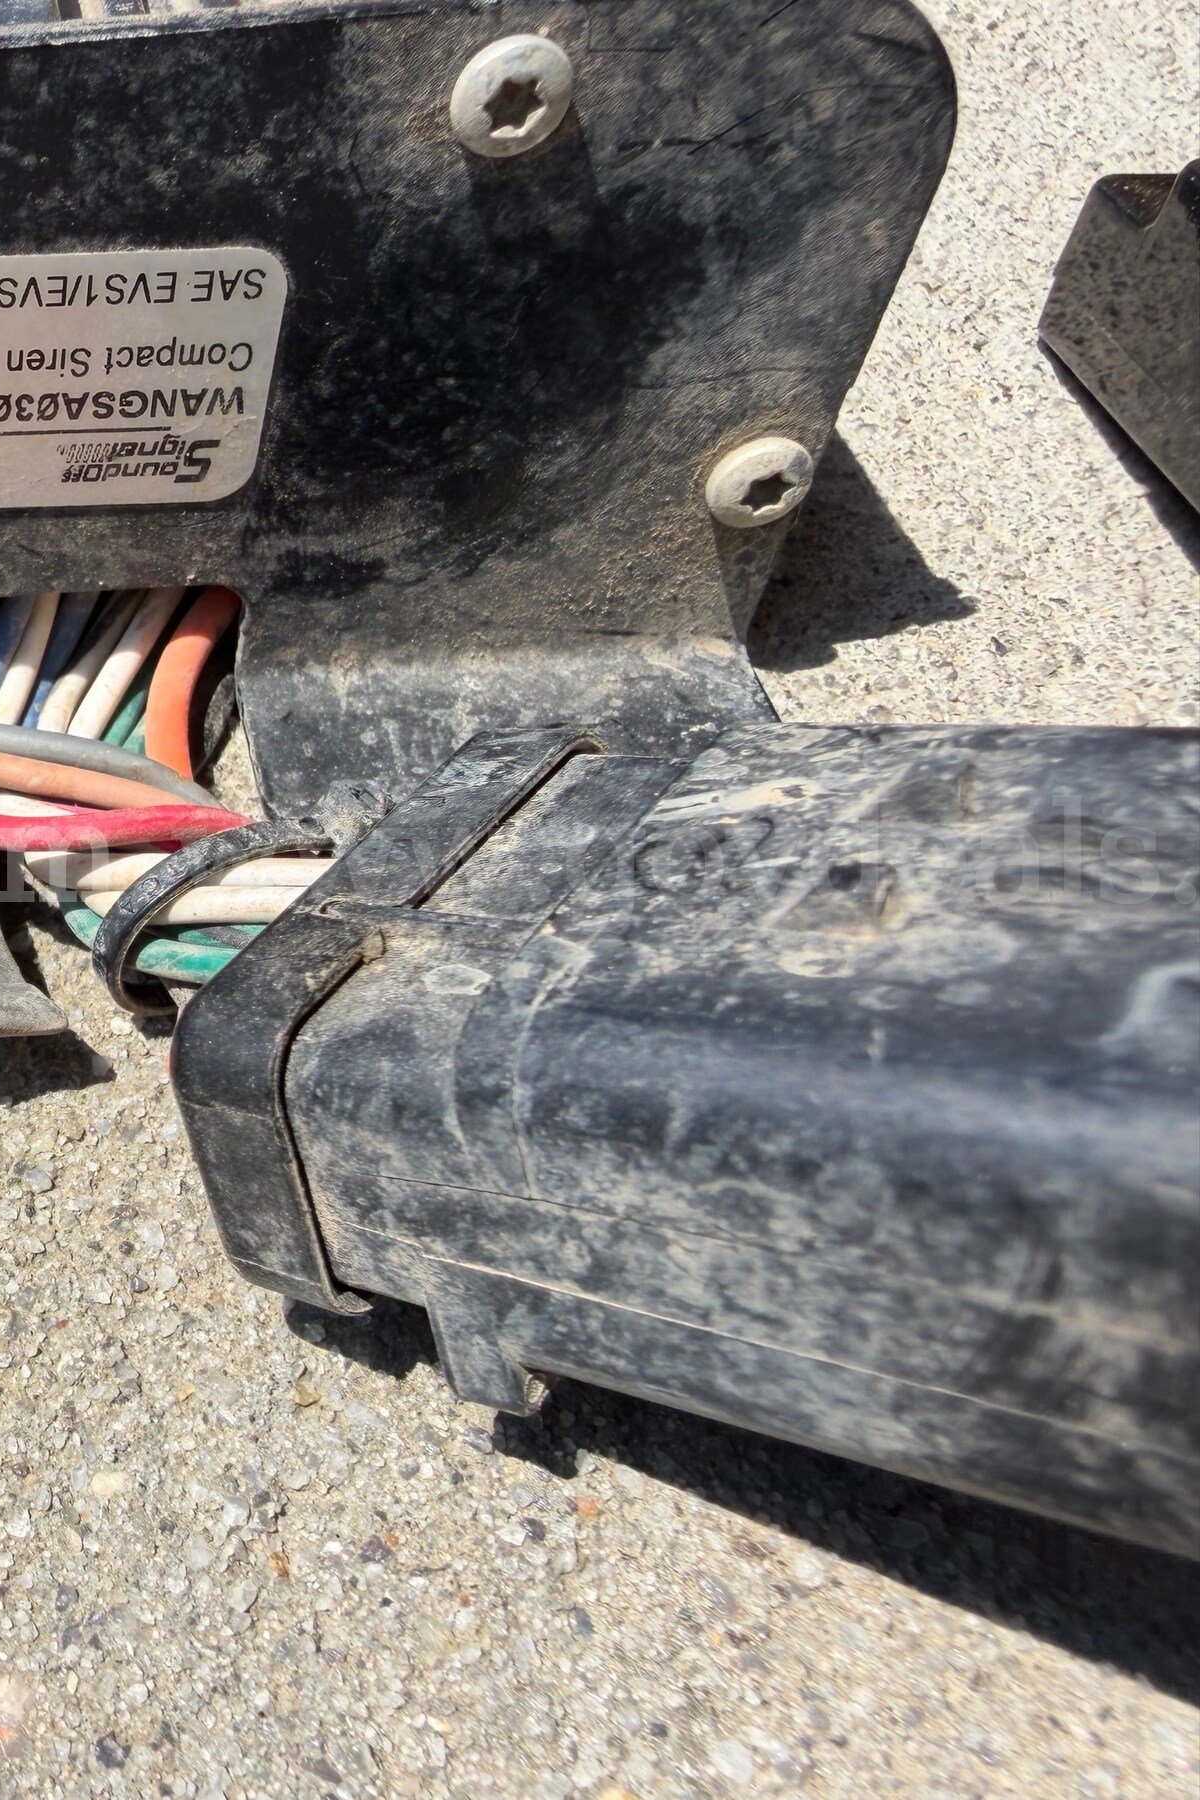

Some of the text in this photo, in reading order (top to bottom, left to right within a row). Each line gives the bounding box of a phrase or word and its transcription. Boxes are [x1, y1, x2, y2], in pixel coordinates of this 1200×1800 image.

[191, 267, 267, 302] SAE
[6, 348, 92, 376] Siren
[104, 337, 254, 375] Compact
